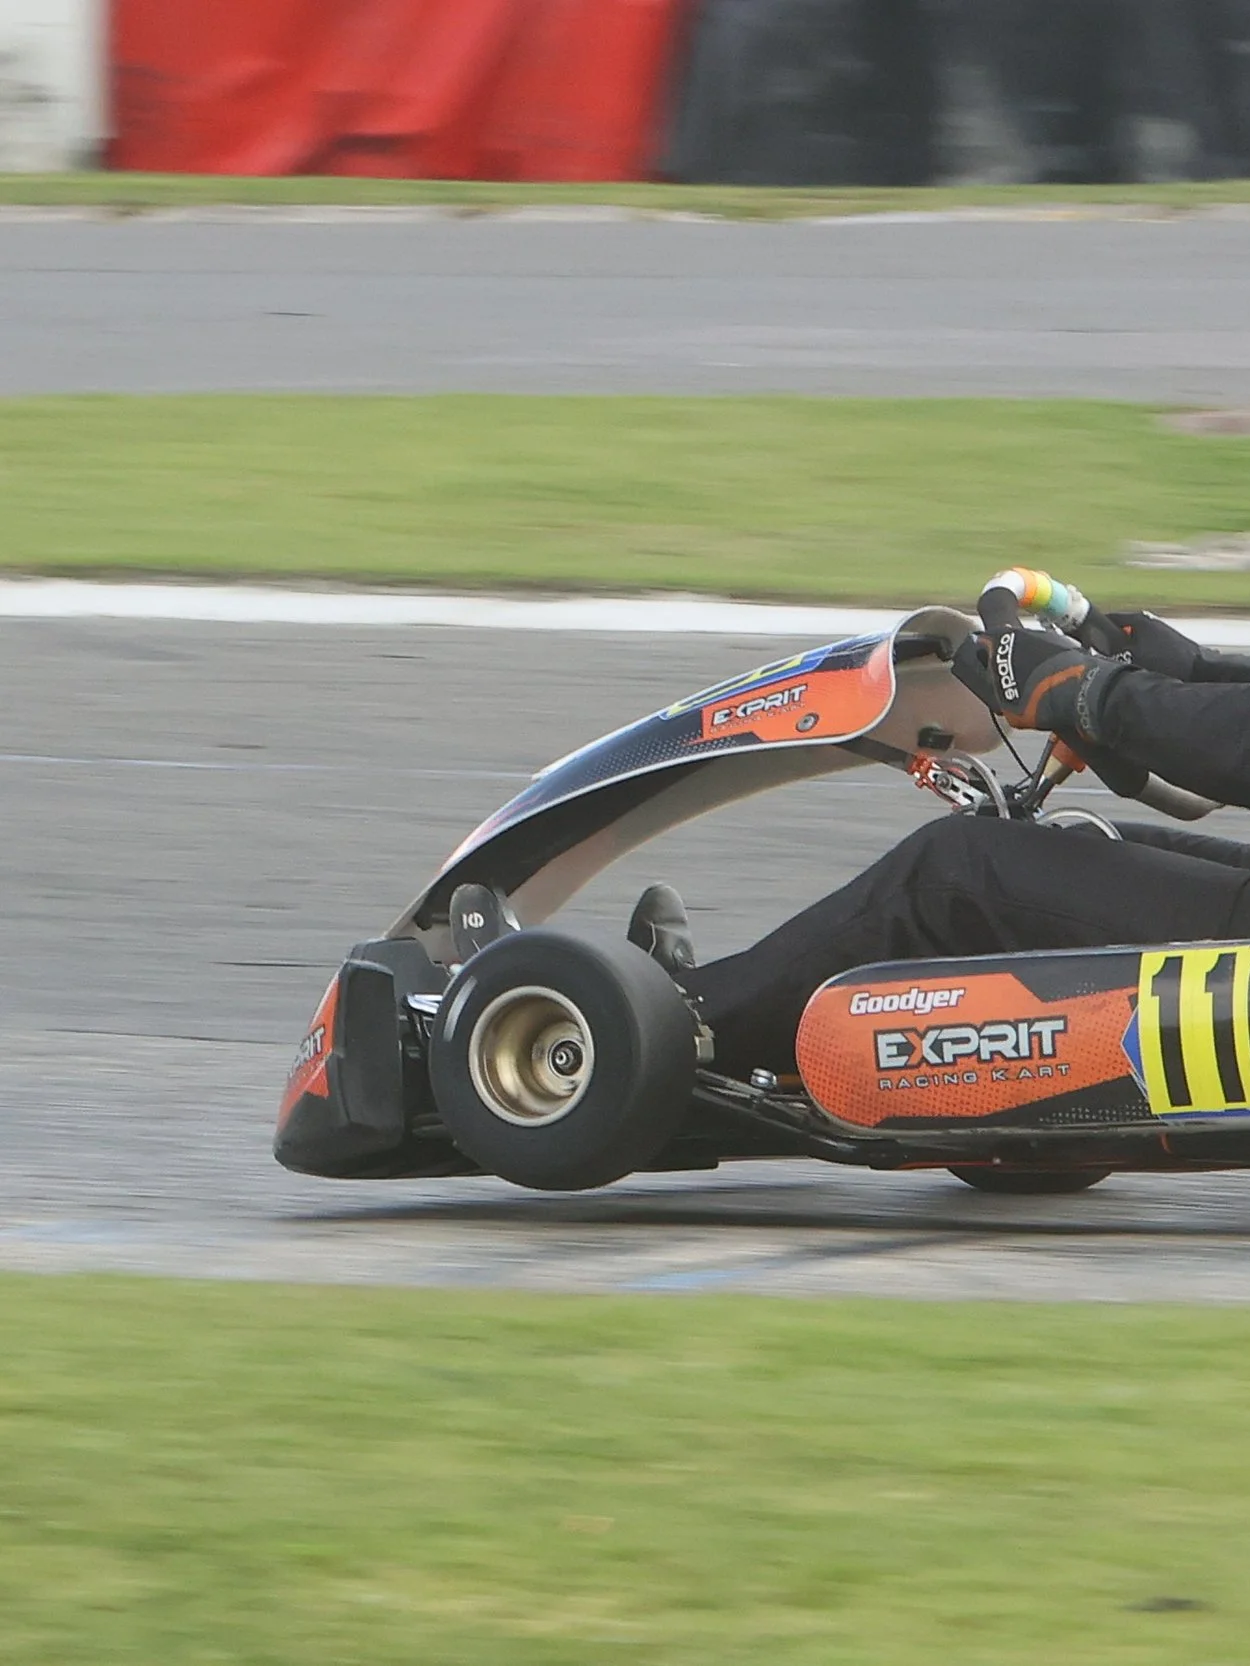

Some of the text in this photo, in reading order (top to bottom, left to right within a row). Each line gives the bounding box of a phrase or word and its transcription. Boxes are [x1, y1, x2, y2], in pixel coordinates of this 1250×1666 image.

[996, 632, 1019, 700] sparco
[712, 684, 808, 726] EXPRIT
[849, 987, 965, 1015] Goodyer
[875, 1017, 1066, 1070] EXPRIT
[879, 1064, 1070, 1091] RACING KART
